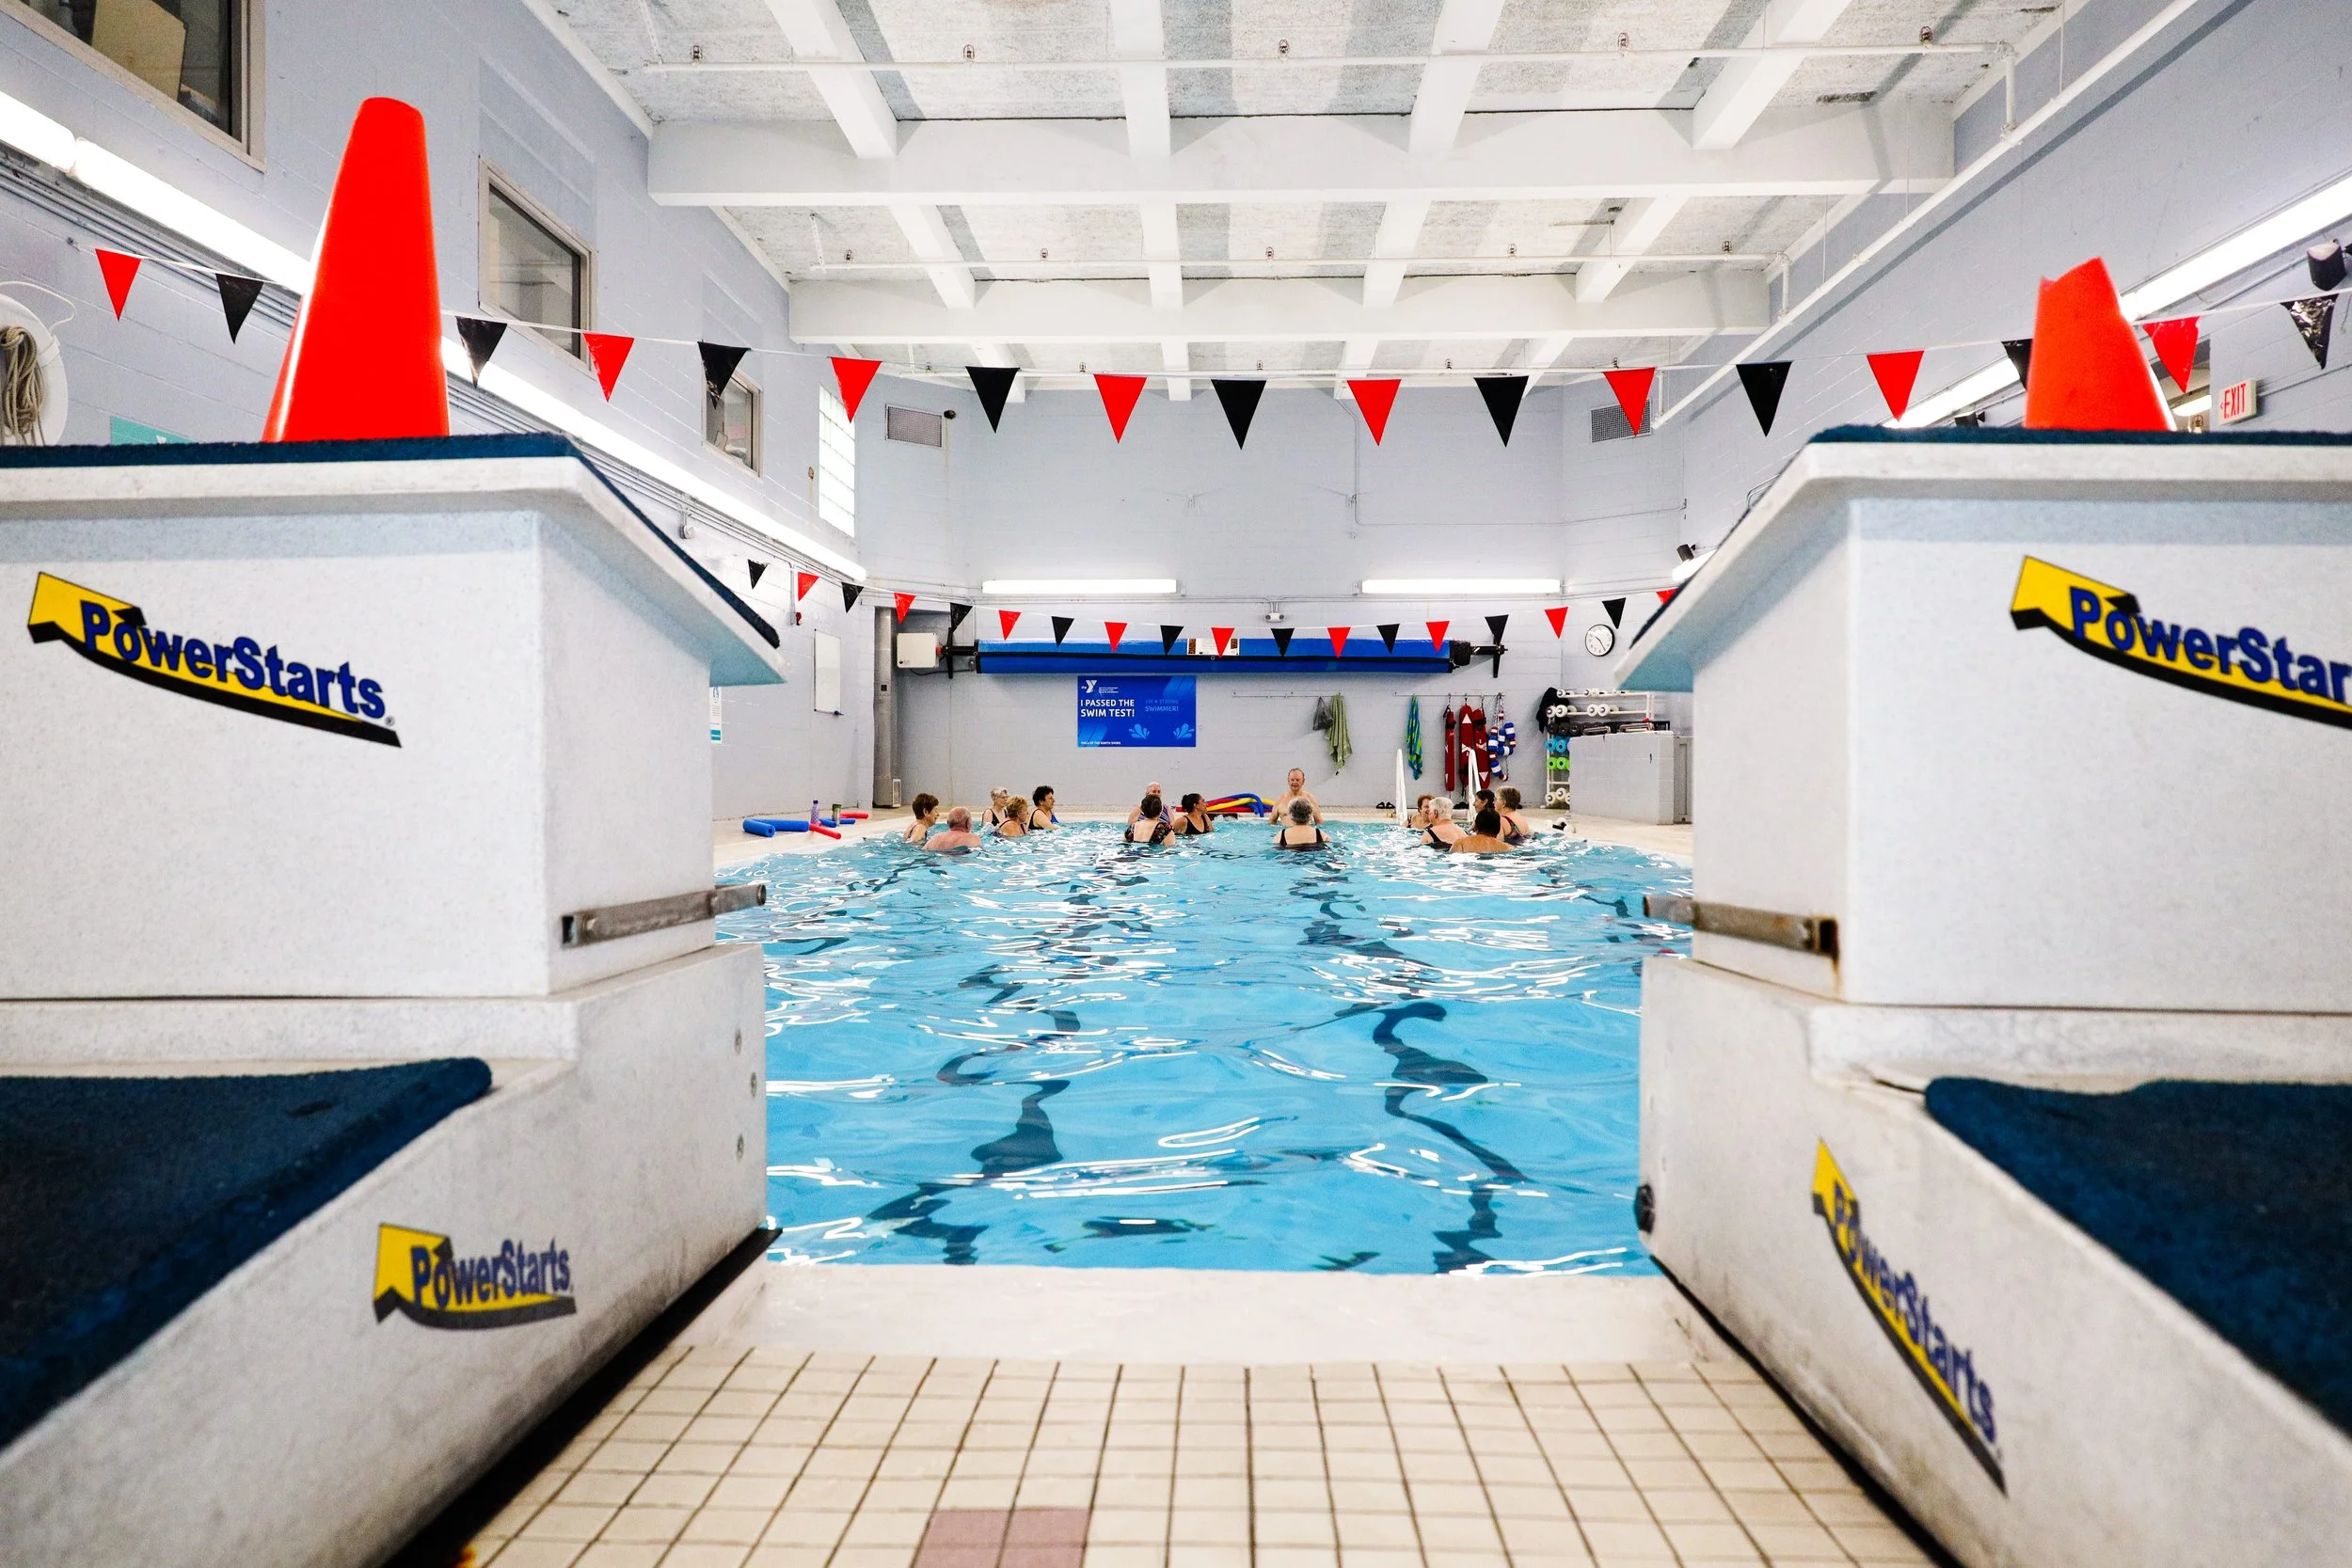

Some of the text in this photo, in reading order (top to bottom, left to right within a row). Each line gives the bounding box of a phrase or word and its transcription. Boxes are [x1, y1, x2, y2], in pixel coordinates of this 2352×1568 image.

[2223, 383, 2247, 420] EXIT
[1080, 708, 1135, 718] SWIM TEST!
[1085, 699, 1117, 707] PASSED
[1118, 699, 1135, 707] THE
[410, 1235, 571, 1310] PowerStarts
[1835, 1180, 1996, 1445] PowerStarts
